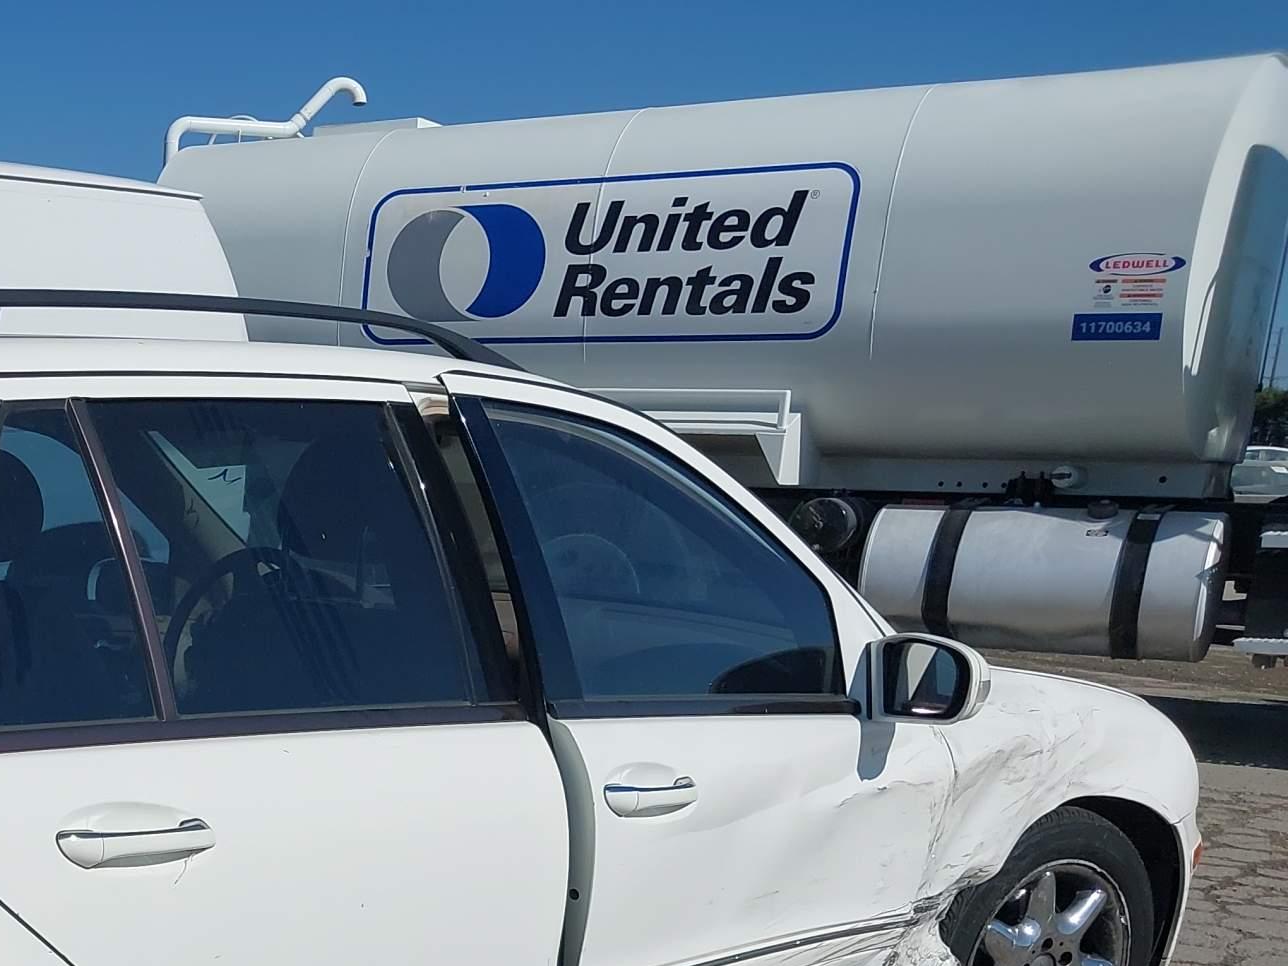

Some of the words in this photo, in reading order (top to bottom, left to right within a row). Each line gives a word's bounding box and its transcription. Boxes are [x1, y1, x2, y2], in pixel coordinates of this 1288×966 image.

[564, 189, 810, 255] United
[1105, 260, 1169, 270] LEDWELL
[553, 256, 816, 318] Rentals
[1080, 321, 1151, 333] 11700634
